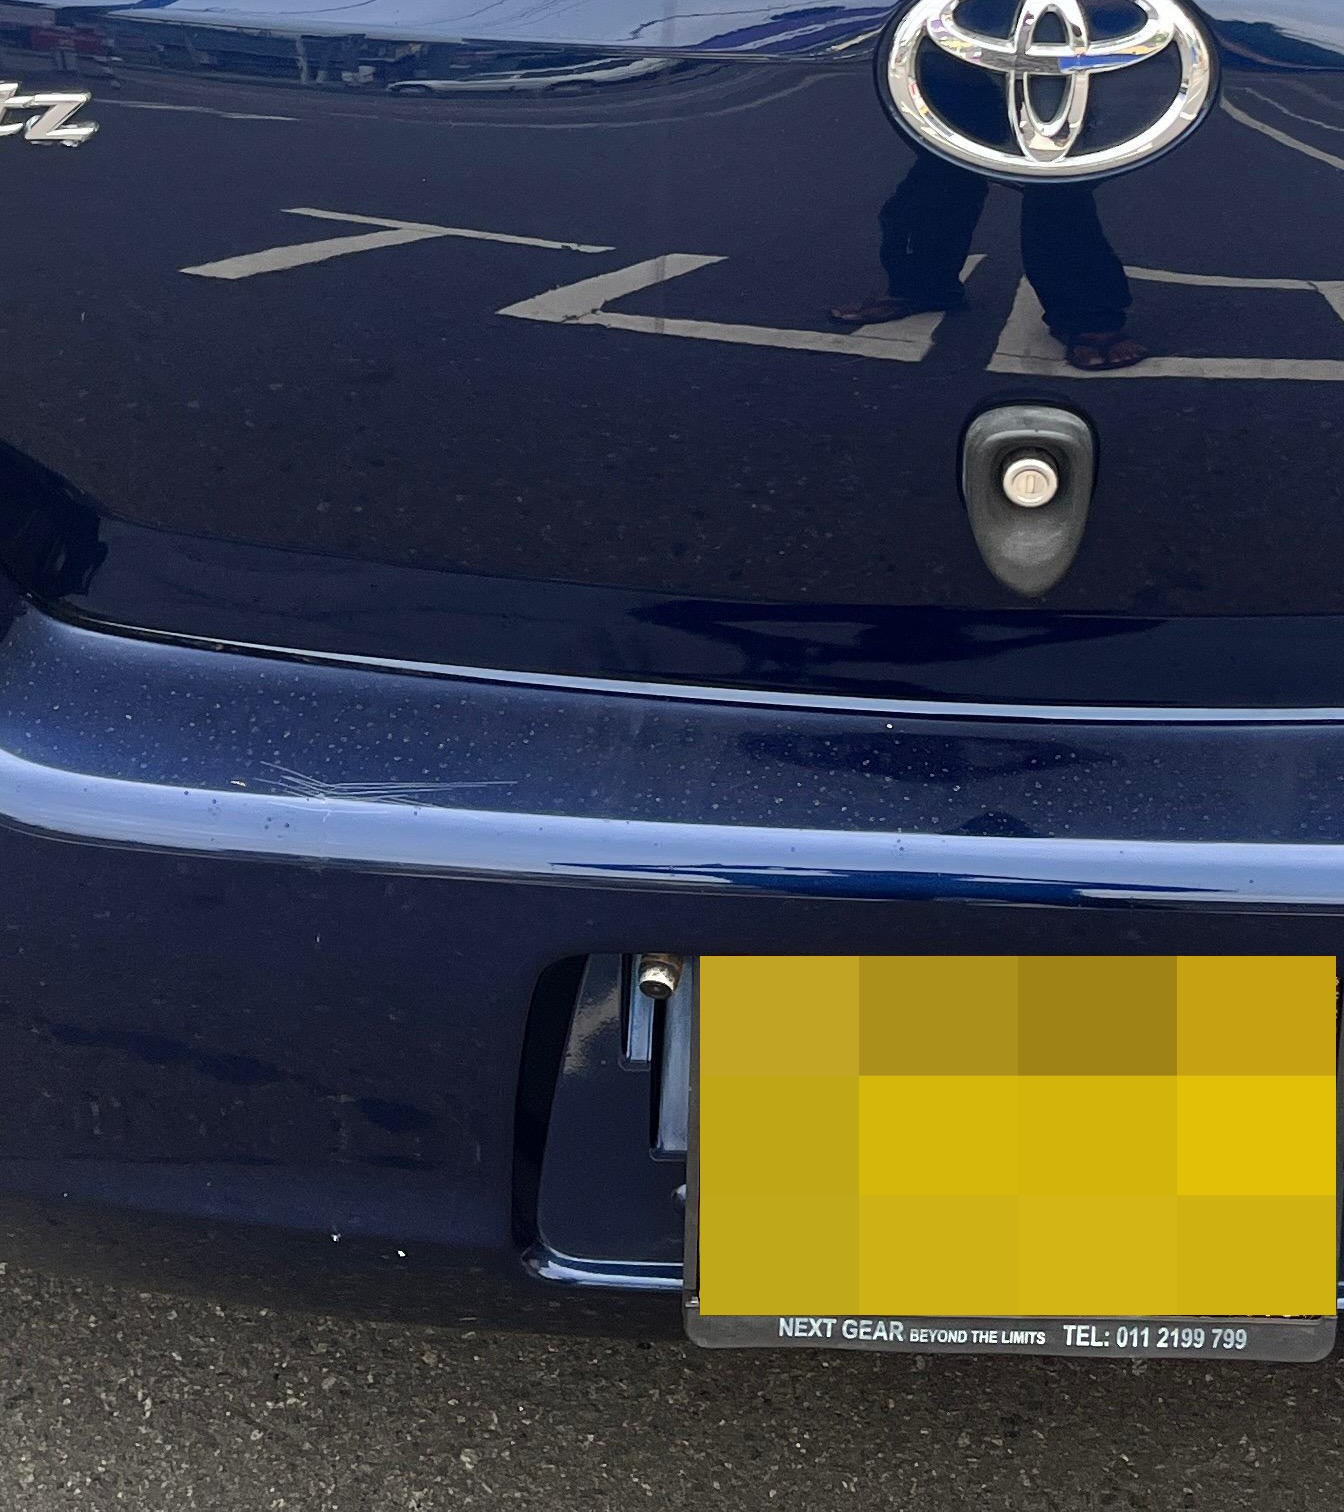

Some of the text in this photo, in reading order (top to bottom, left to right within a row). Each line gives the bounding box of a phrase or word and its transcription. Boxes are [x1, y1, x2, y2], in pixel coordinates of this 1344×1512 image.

[778, 1317, 1248, 1350] NEXT GEAR BEYOND THE LIMITS TEL: 011 2199 799
